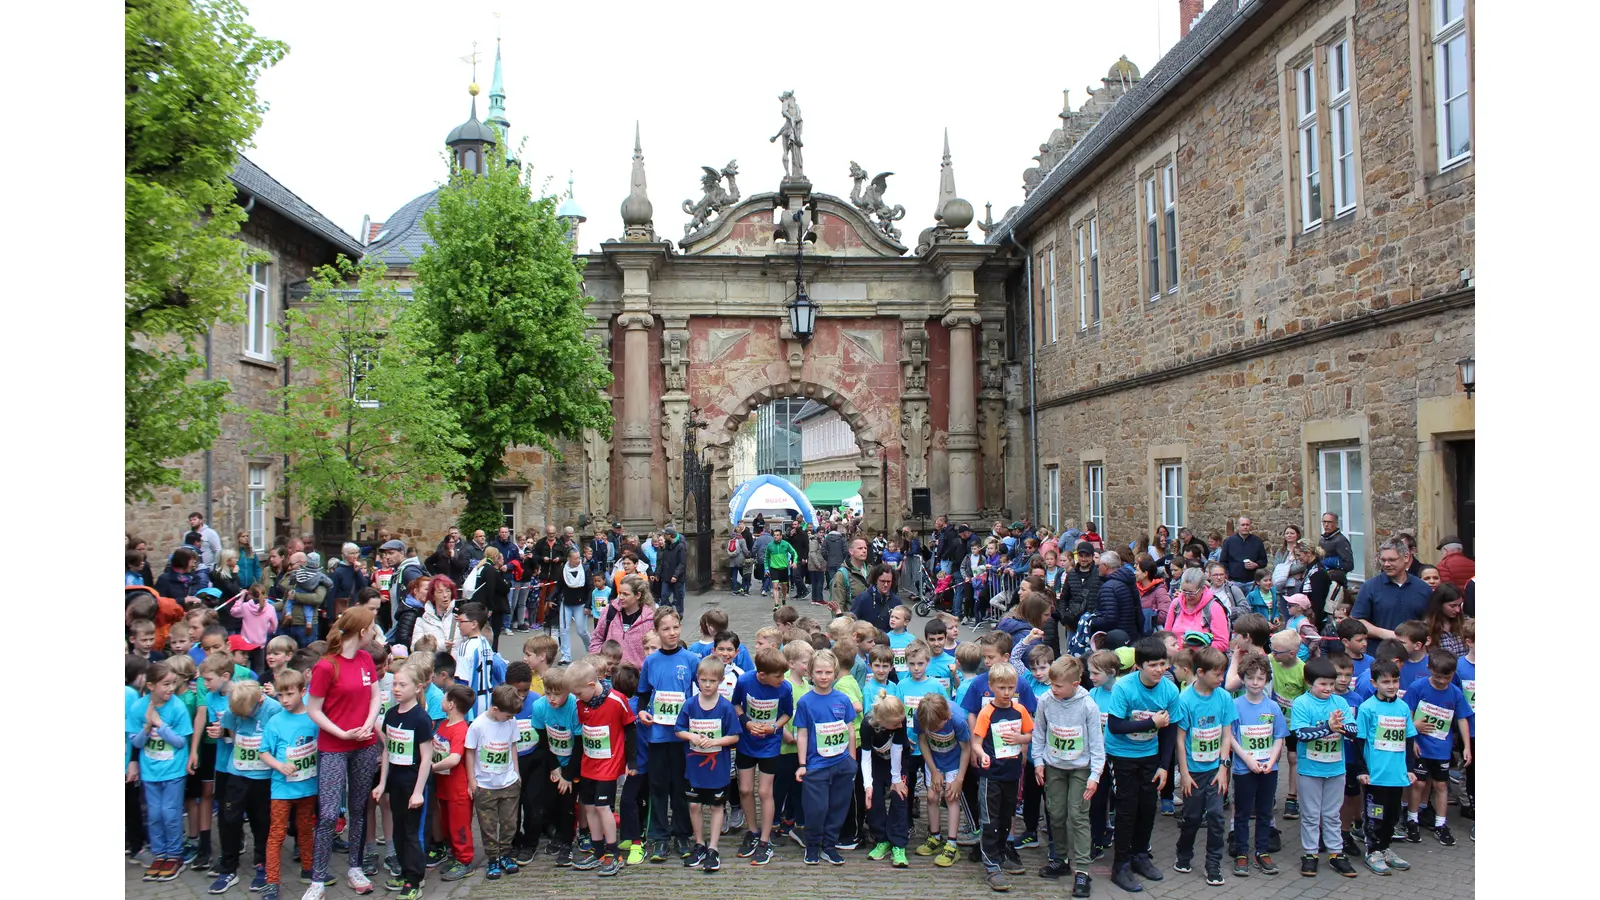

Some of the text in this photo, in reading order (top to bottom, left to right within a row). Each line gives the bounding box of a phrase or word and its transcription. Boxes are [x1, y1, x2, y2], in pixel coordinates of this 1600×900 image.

[659, 703, 679, 715] 441
[750, 708, 771, 720] 525
[824, 732, 845, 747] 432
[1383, 729, 1405, 742] 498
[1054, 737, 1076, 751] 472
[1199, 738, 1220, 752] 515
[1249, 737, 1270, 750] 381
[1314, 740, 1337, 753] 512
[294, 756, 316, 773] 504
[487, 752, 507, 764] 524
